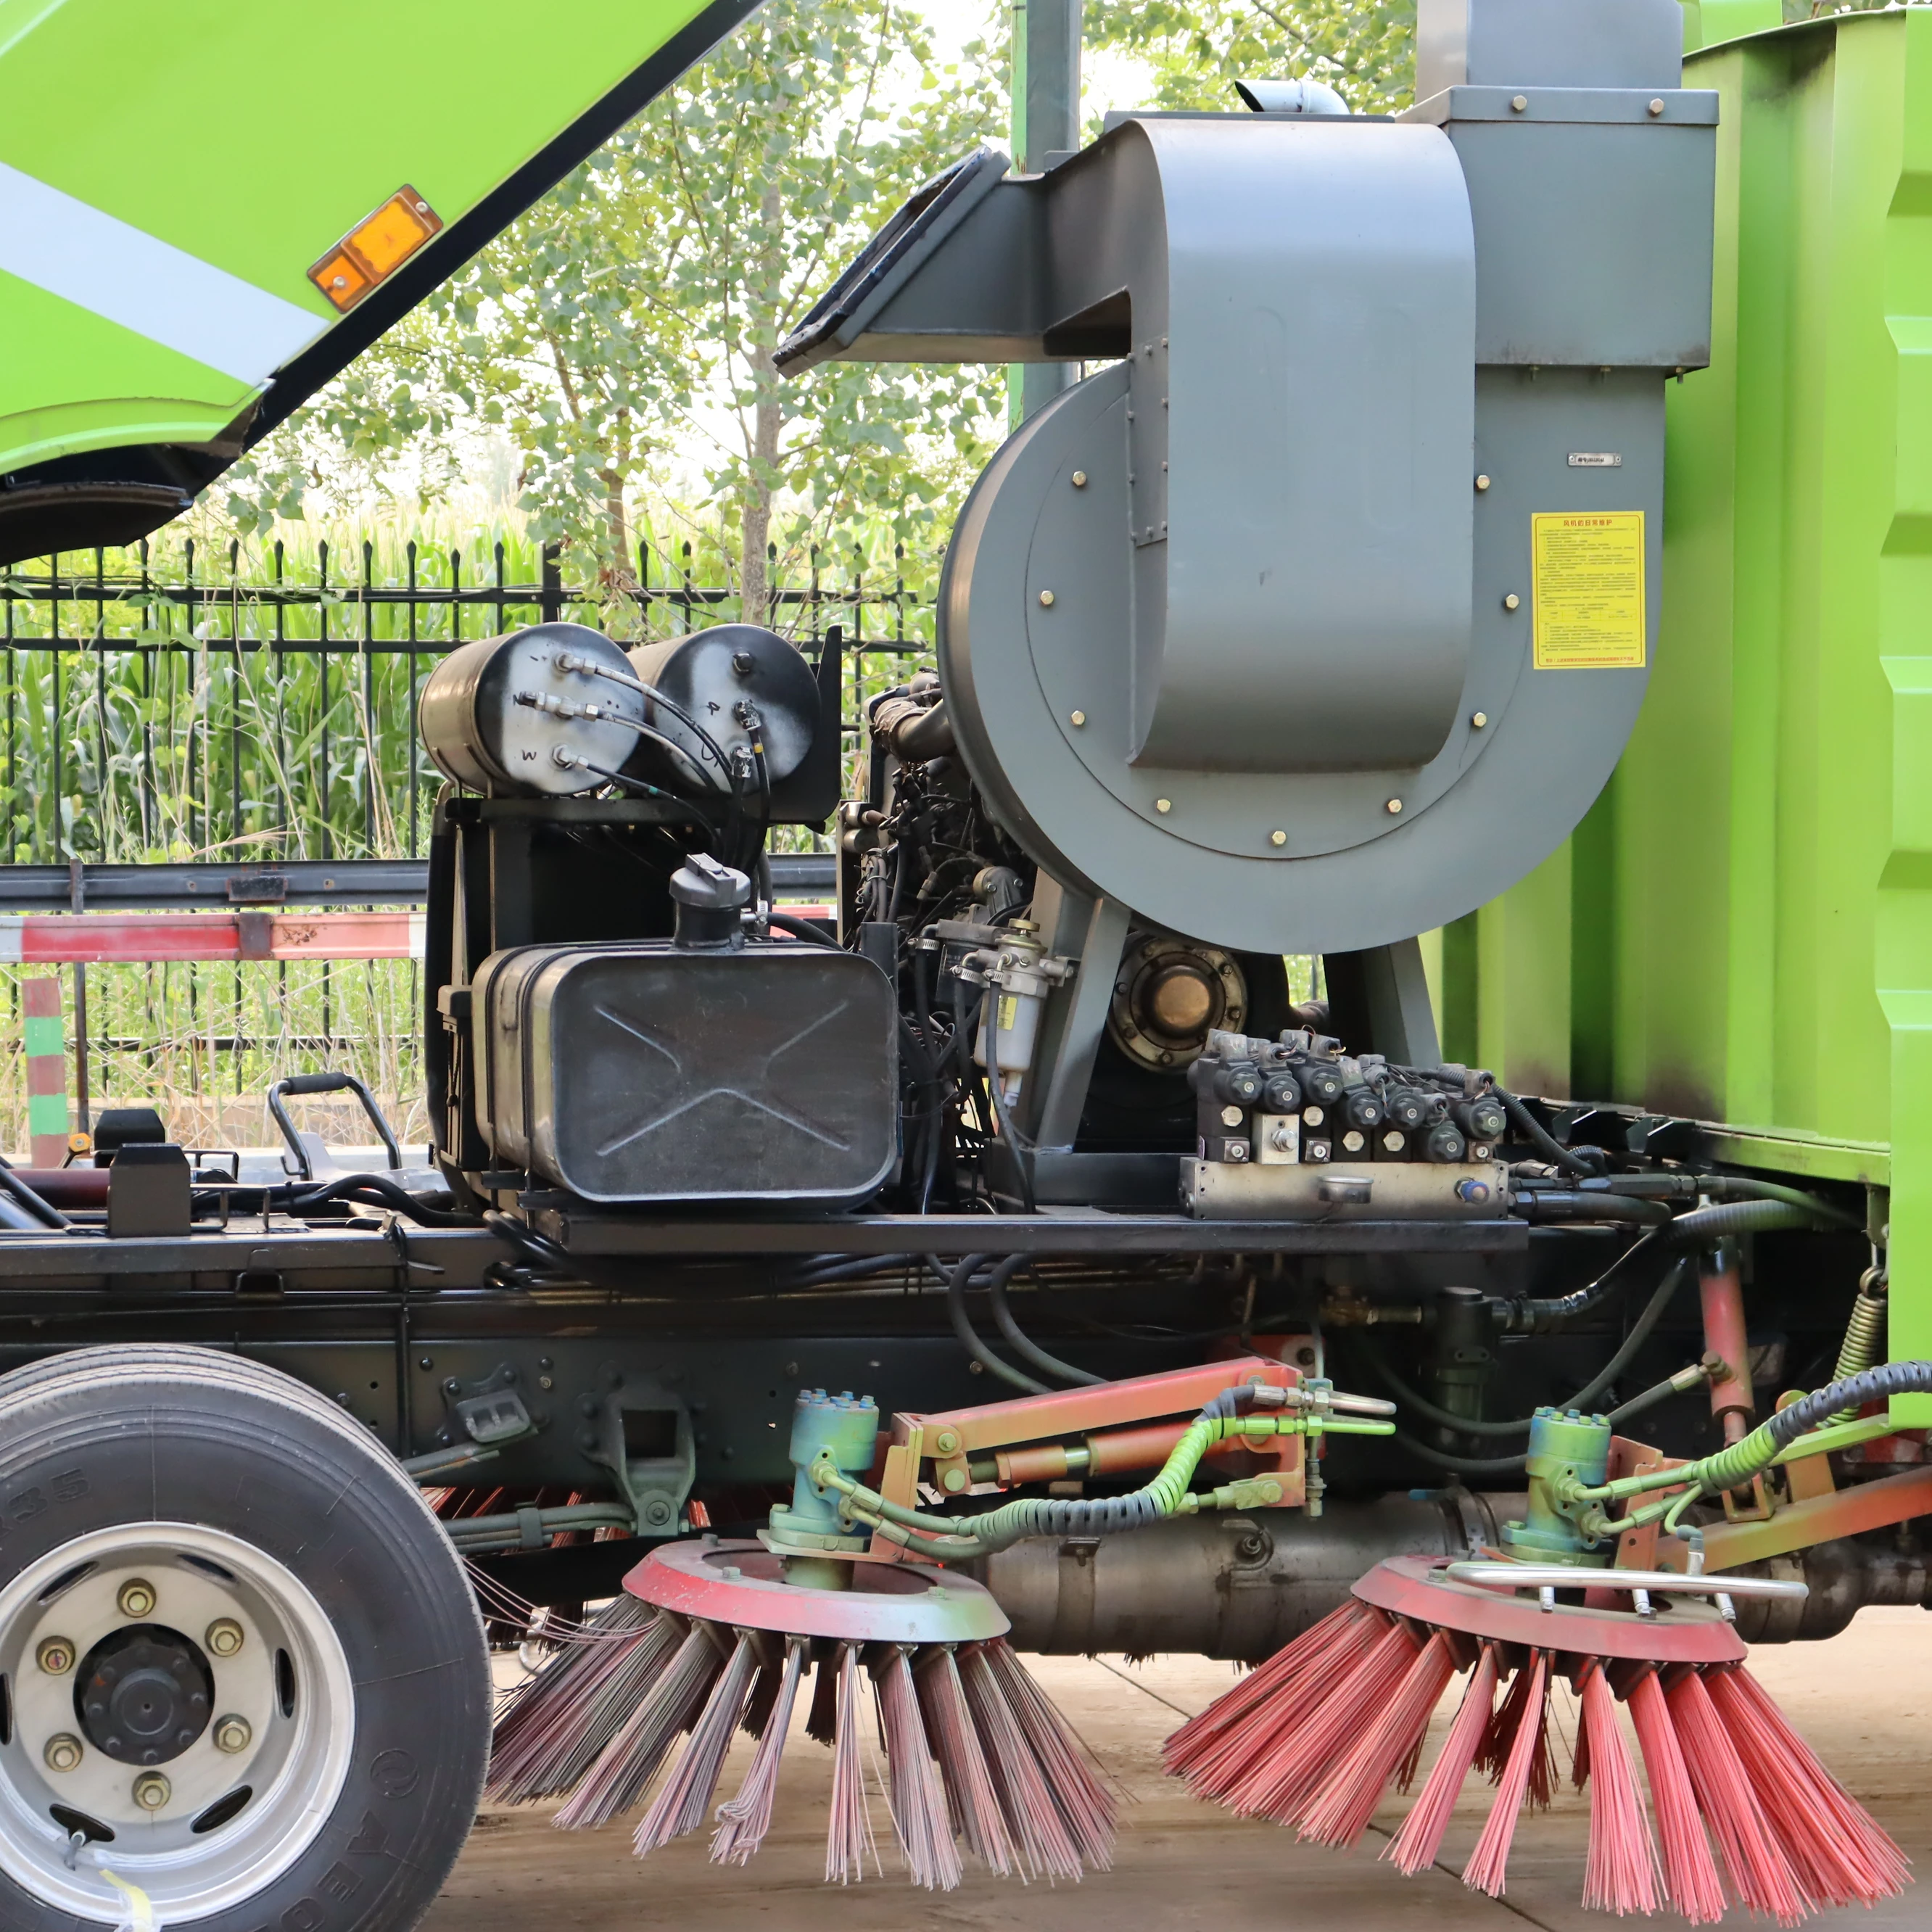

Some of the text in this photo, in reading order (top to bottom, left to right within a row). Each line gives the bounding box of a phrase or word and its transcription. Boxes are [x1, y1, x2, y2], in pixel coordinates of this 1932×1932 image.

[1563, 519, 1613, 527] 风机的日常维护
